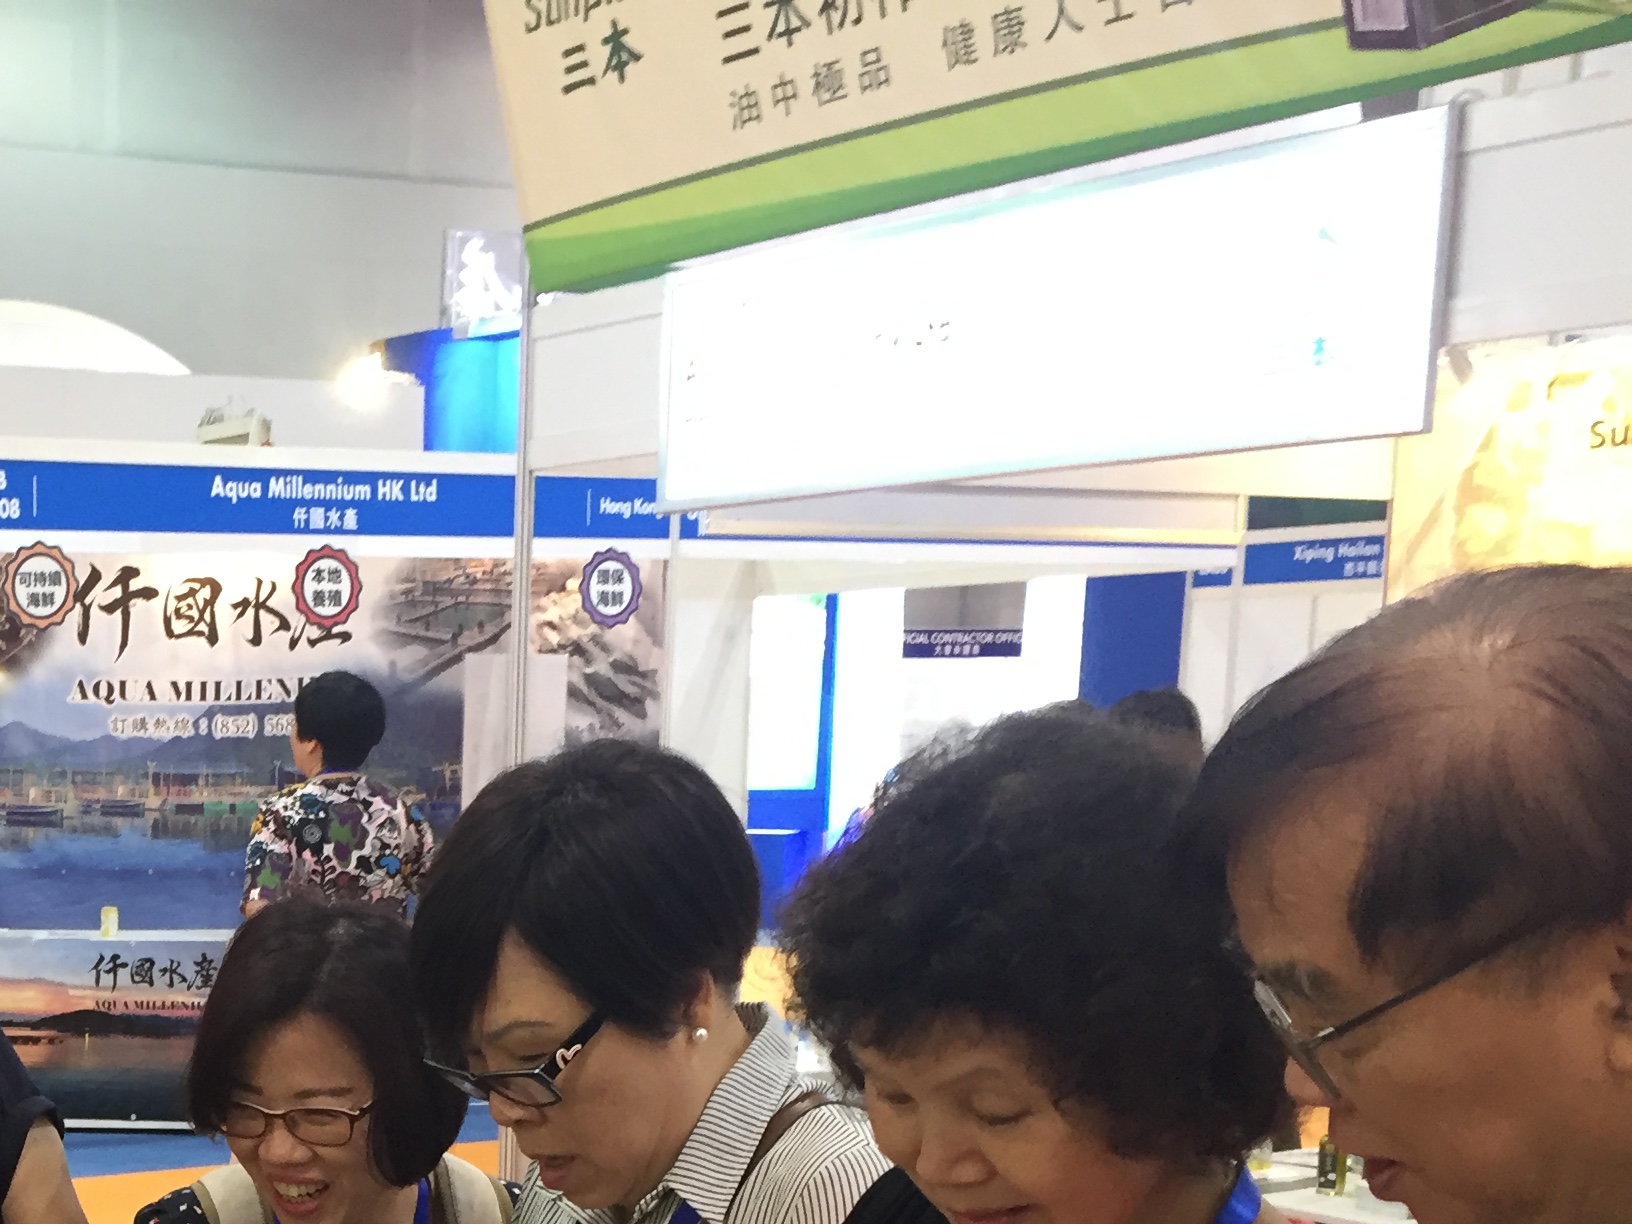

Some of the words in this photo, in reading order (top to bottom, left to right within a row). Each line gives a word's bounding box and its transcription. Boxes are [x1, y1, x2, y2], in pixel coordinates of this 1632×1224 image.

[715, 0, 912, 66] 三本初
[561, 18, 645, 95] 三本
[728, 46, 892, 130] 油中極品
[941, 0, 1194, 72] 健康人士
[211, 475, 262, 504] Aqua
[268, 475, 372, 501] Millennium
[377, 478, 405, 502] HK
[410, 479, 438, 502] Ltd
[599, 496, 631, 519] Hong
[311, 566, 342, 585] 本地
[70, 679, 158, 705] AQUA
[167, 679, 316, 702] MILLENI
[212, 712, 258, 737] (852)
[268, 713, 294, 735] 568
[93, 1000, 130, 1012] AQUA
